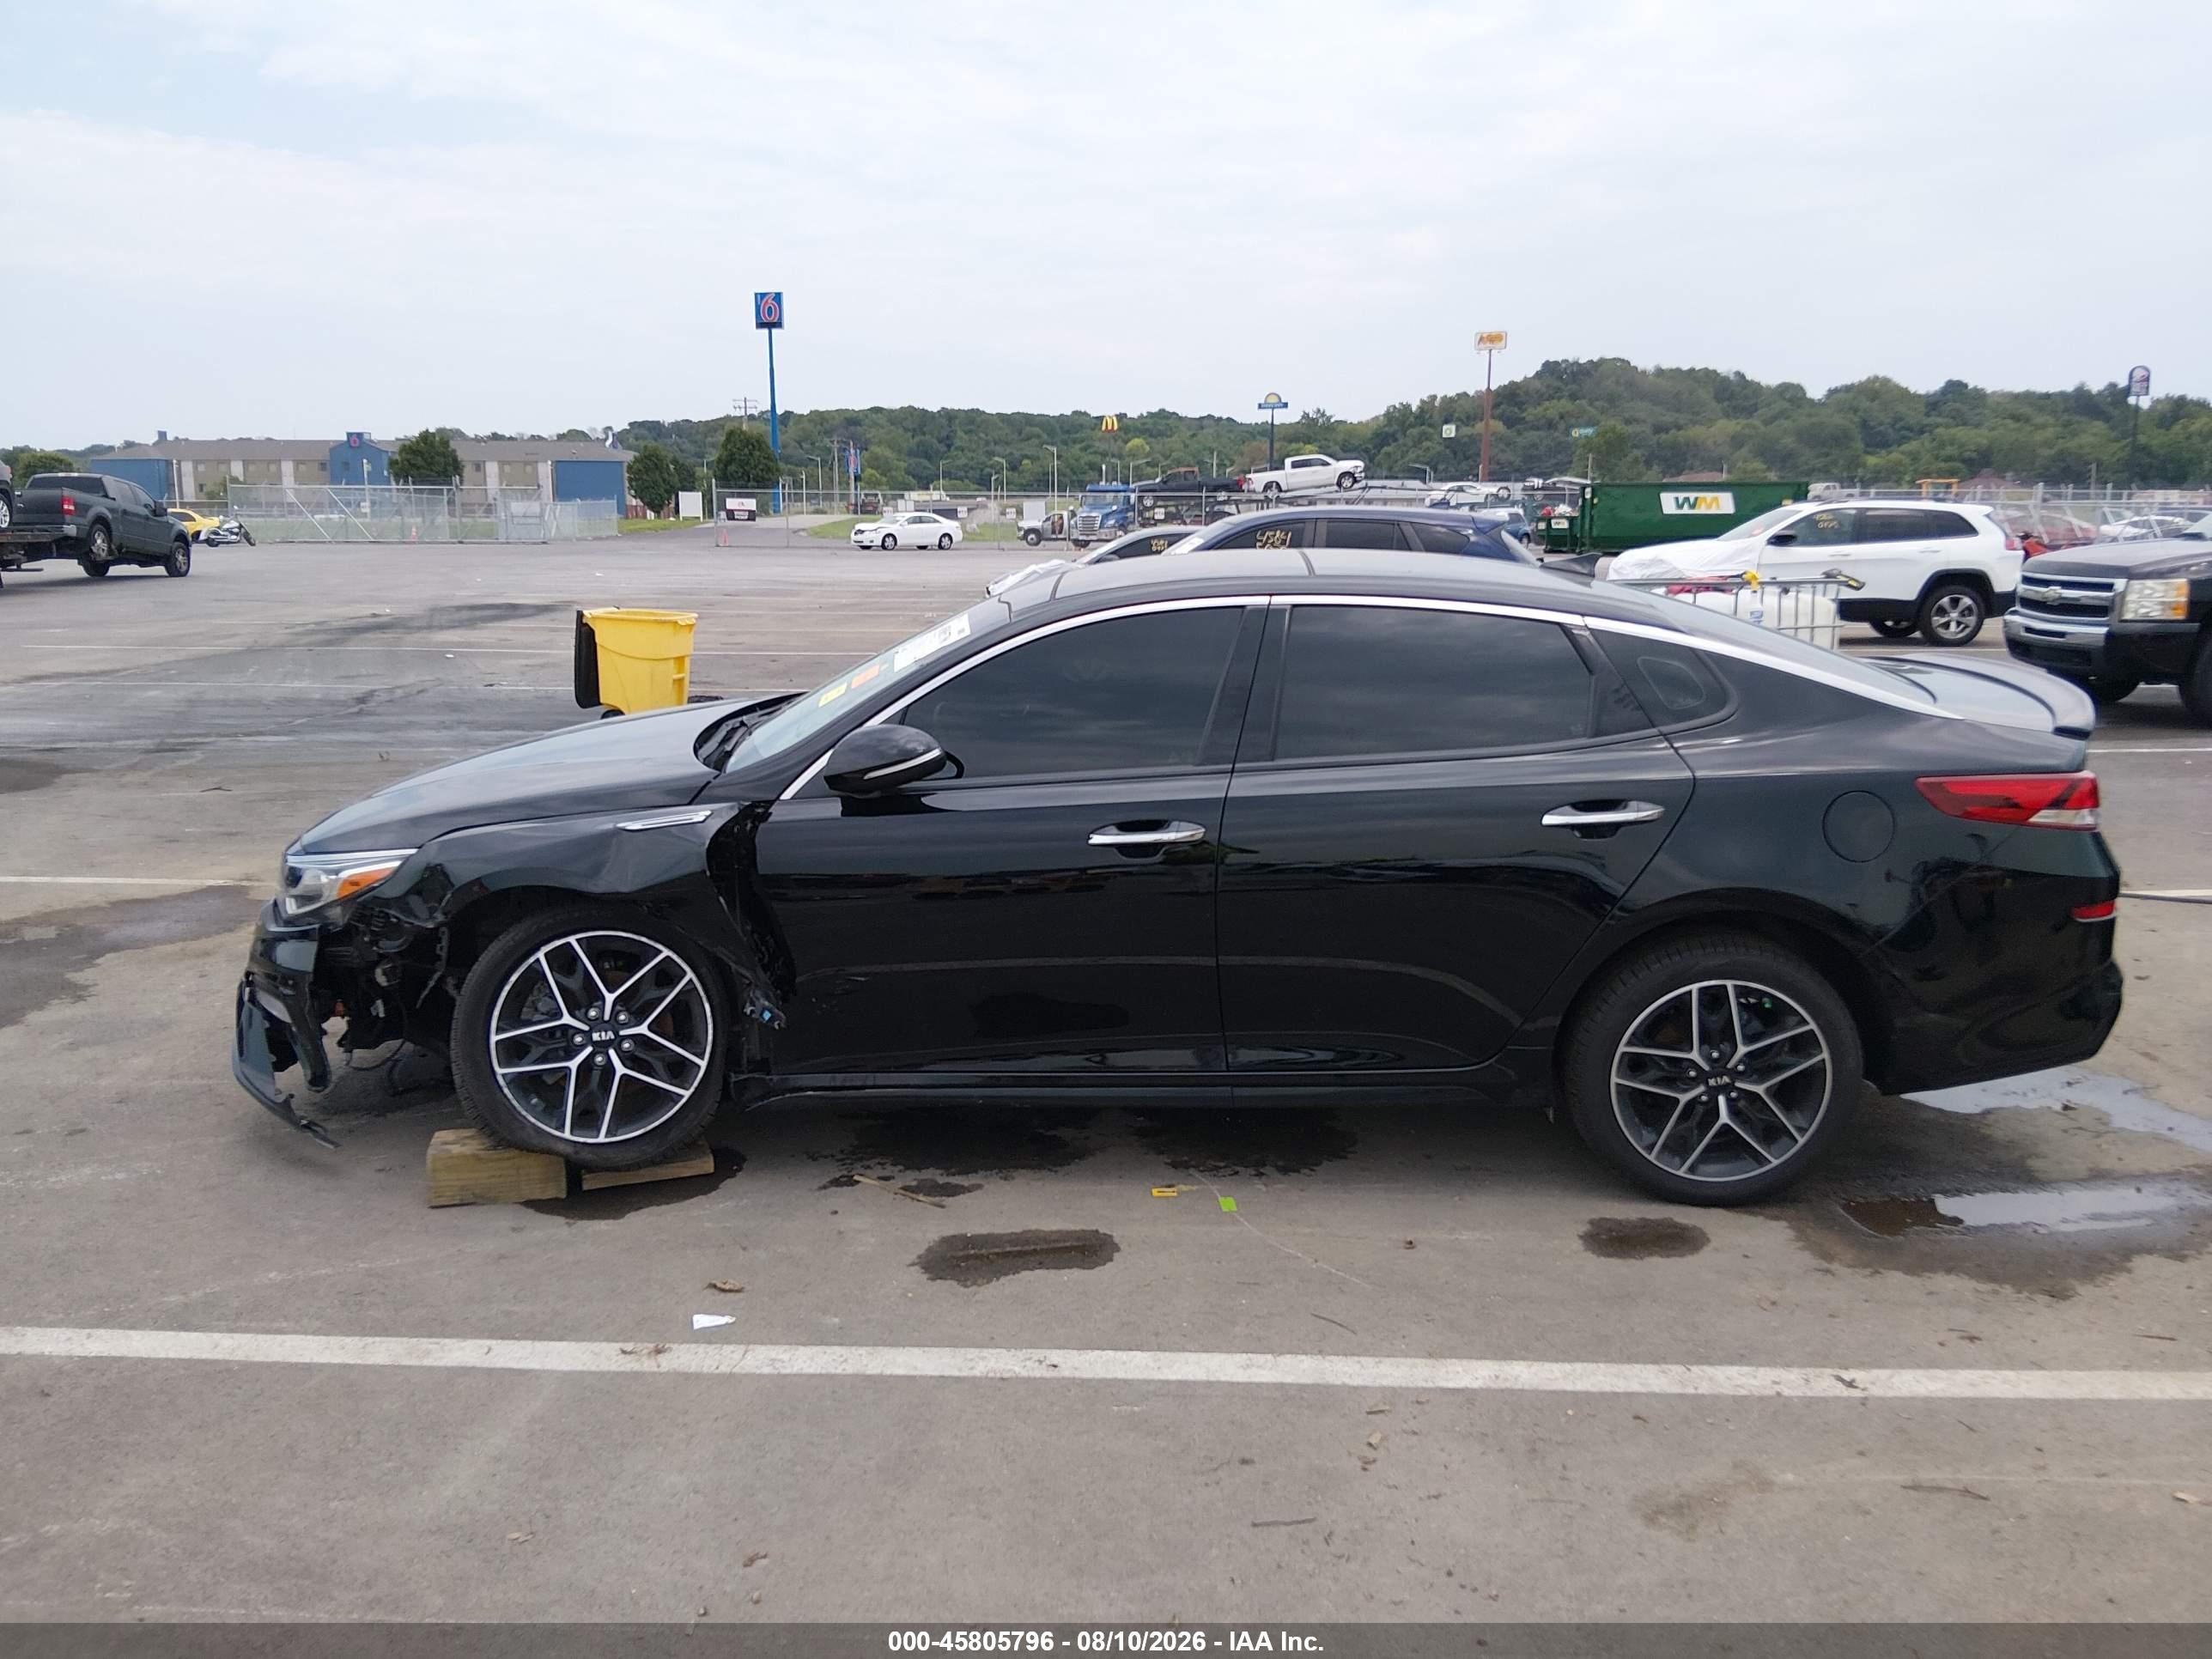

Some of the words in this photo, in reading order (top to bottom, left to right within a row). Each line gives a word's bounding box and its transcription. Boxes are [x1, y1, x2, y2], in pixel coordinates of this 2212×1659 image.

[760, 292, 779, 323] 6
[1674, 496, 1720, 510] WM
[592, 1030, 615, 1042] KIA
[1708, 1075, 1731, 1086] KIA
